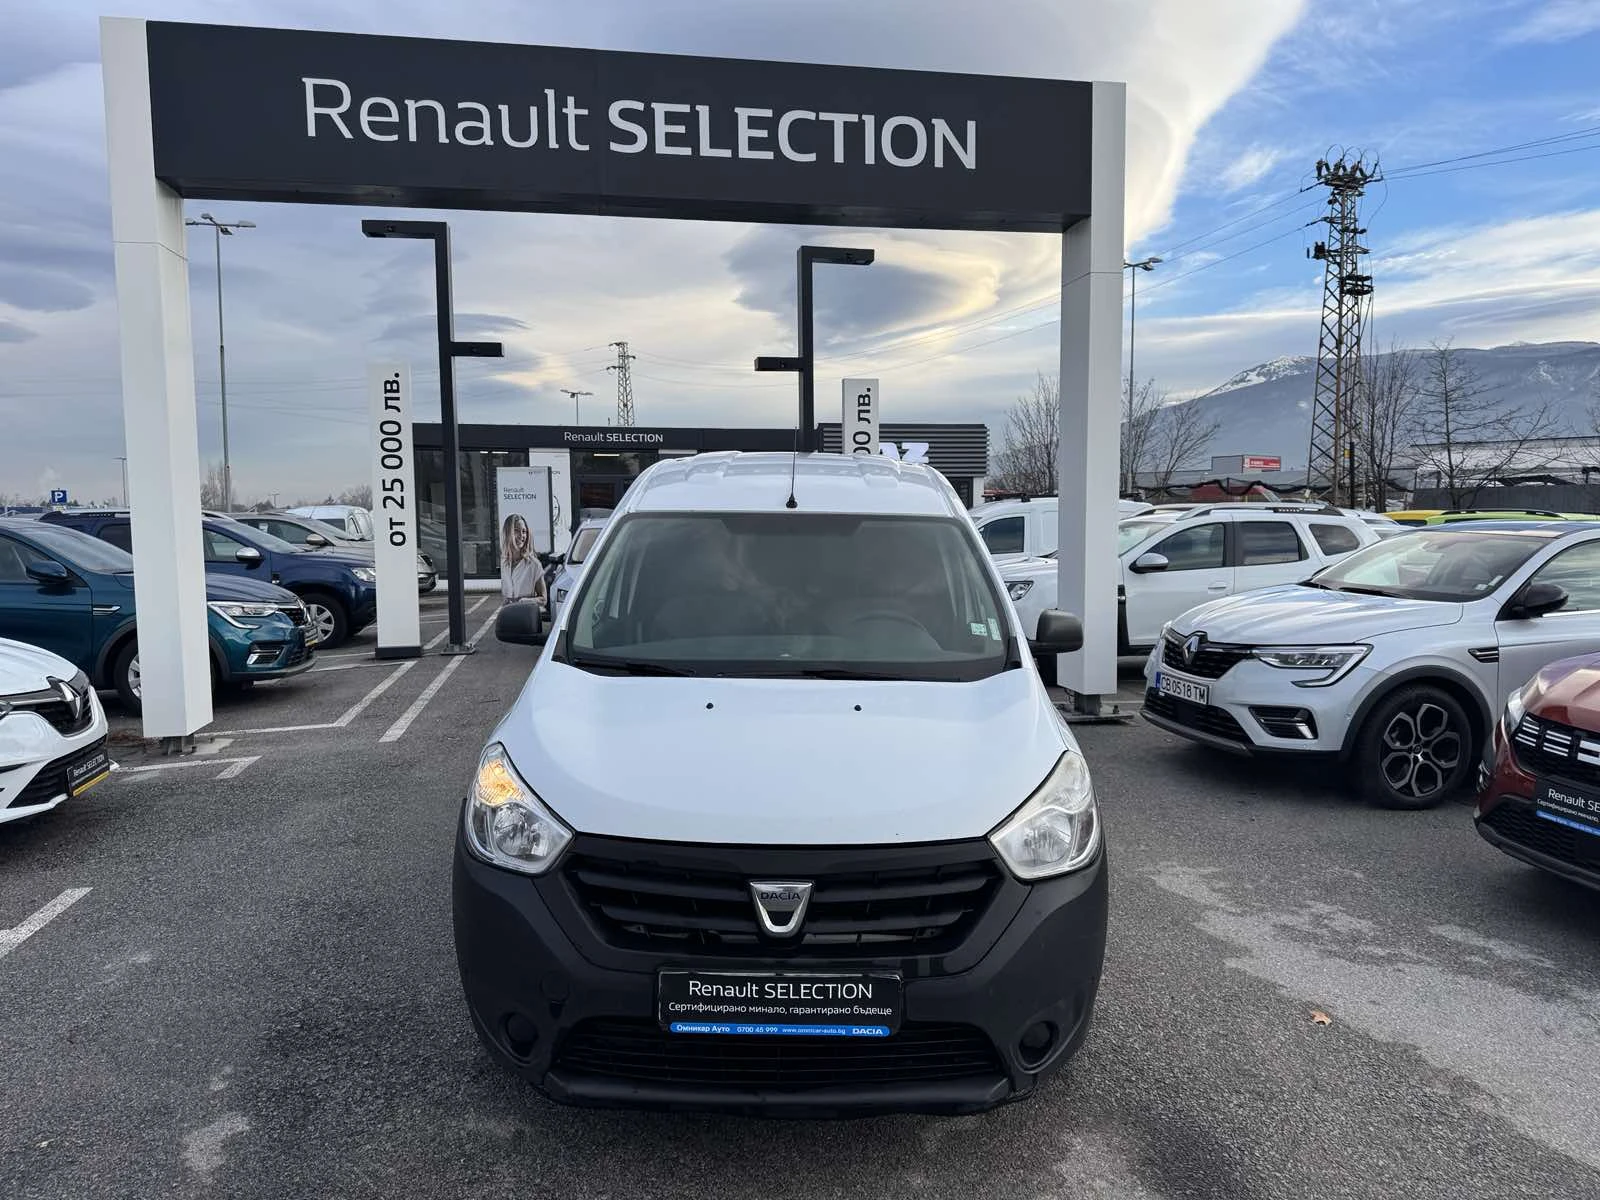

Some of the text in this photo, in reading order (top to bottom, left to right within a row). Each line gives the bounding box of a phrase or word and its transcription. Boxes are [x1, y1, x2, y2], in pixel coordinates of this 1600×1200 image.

[301, 76, 977, 170] Renault SELECTION
[858, 387, 871, 424] лв.
[564, 431, 664, 443] Renault SELECTION
[379, 372, 406, 547] от 25 000 лв.
[1548, 788, 1586, 809] Renault
[760, 892, 801, 900] DACIA
[689, 980, 873, 999] Renault SELECTION
[668, 1002, 893, 1016] Сертифицирано минало, гарантирано бъдеще
[676, 1024, 710, 1034] Омникар
[711, 1025, 731, 1035] Ауто
[736, 1026, 754, 1034] 0700
[755, 1026, 764, 1034] 45
[765, 1026, 778, 1034] 999
[852, 1028, 884, 1036] DACIA
